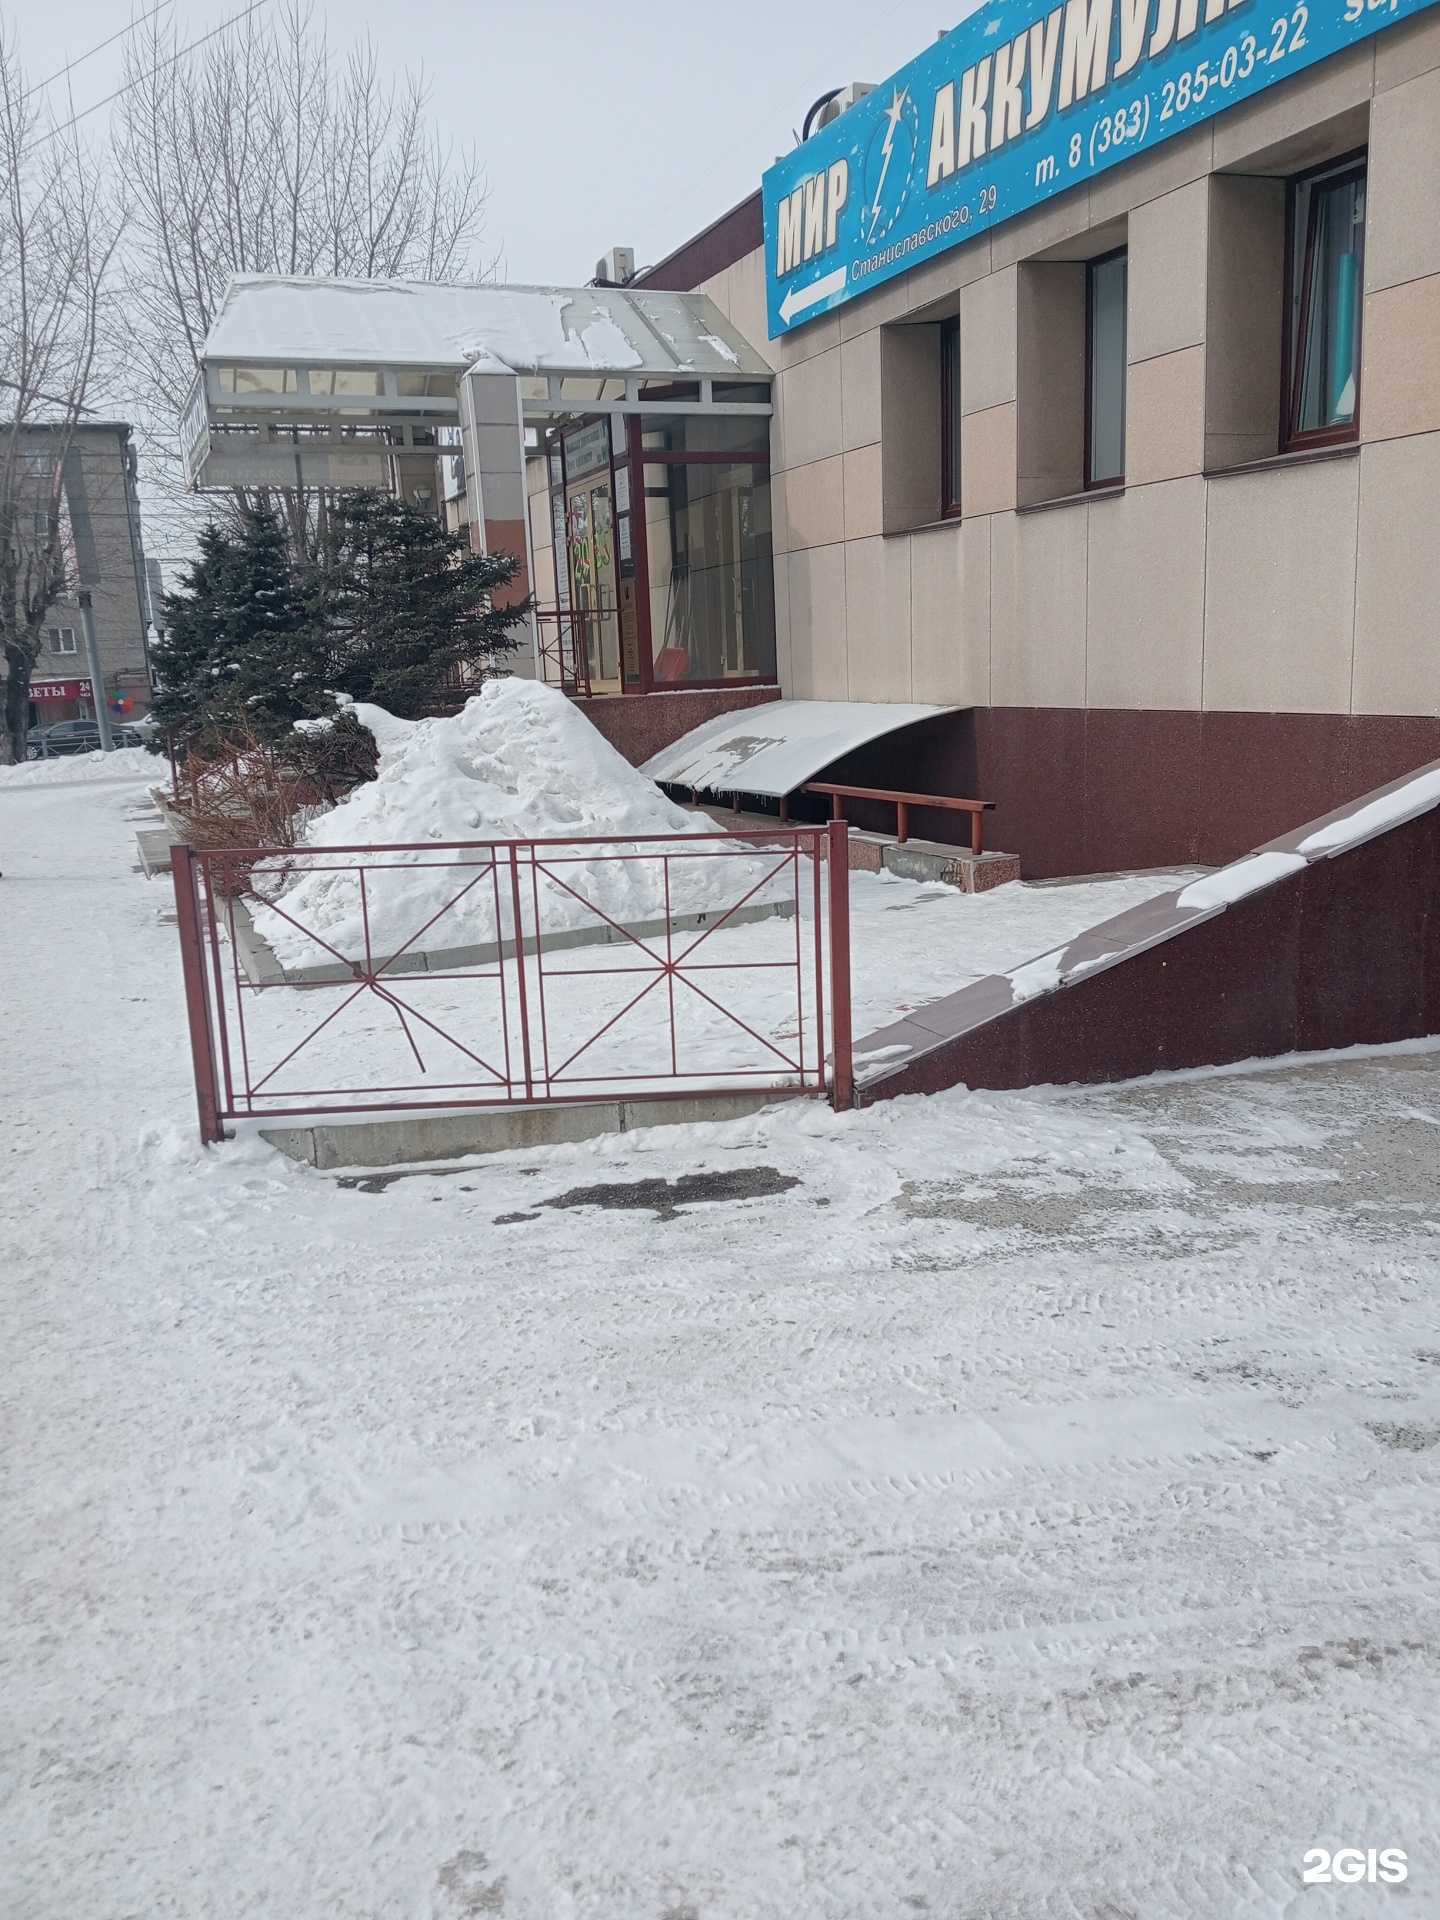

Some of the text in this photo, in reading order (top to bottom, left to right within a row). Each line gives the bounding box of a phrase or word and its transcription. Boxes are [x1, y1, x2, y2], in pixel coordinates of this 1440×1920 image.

[776, 0, 1249, 279] МИР АККУМУ
[1068, 132, 1082, 168] 8
[1089, 94, 1150, 167] (383)
[1159, 6, 1308, 122] 285-03-22
[851, 184, 997, 281] Станиславского, 29
